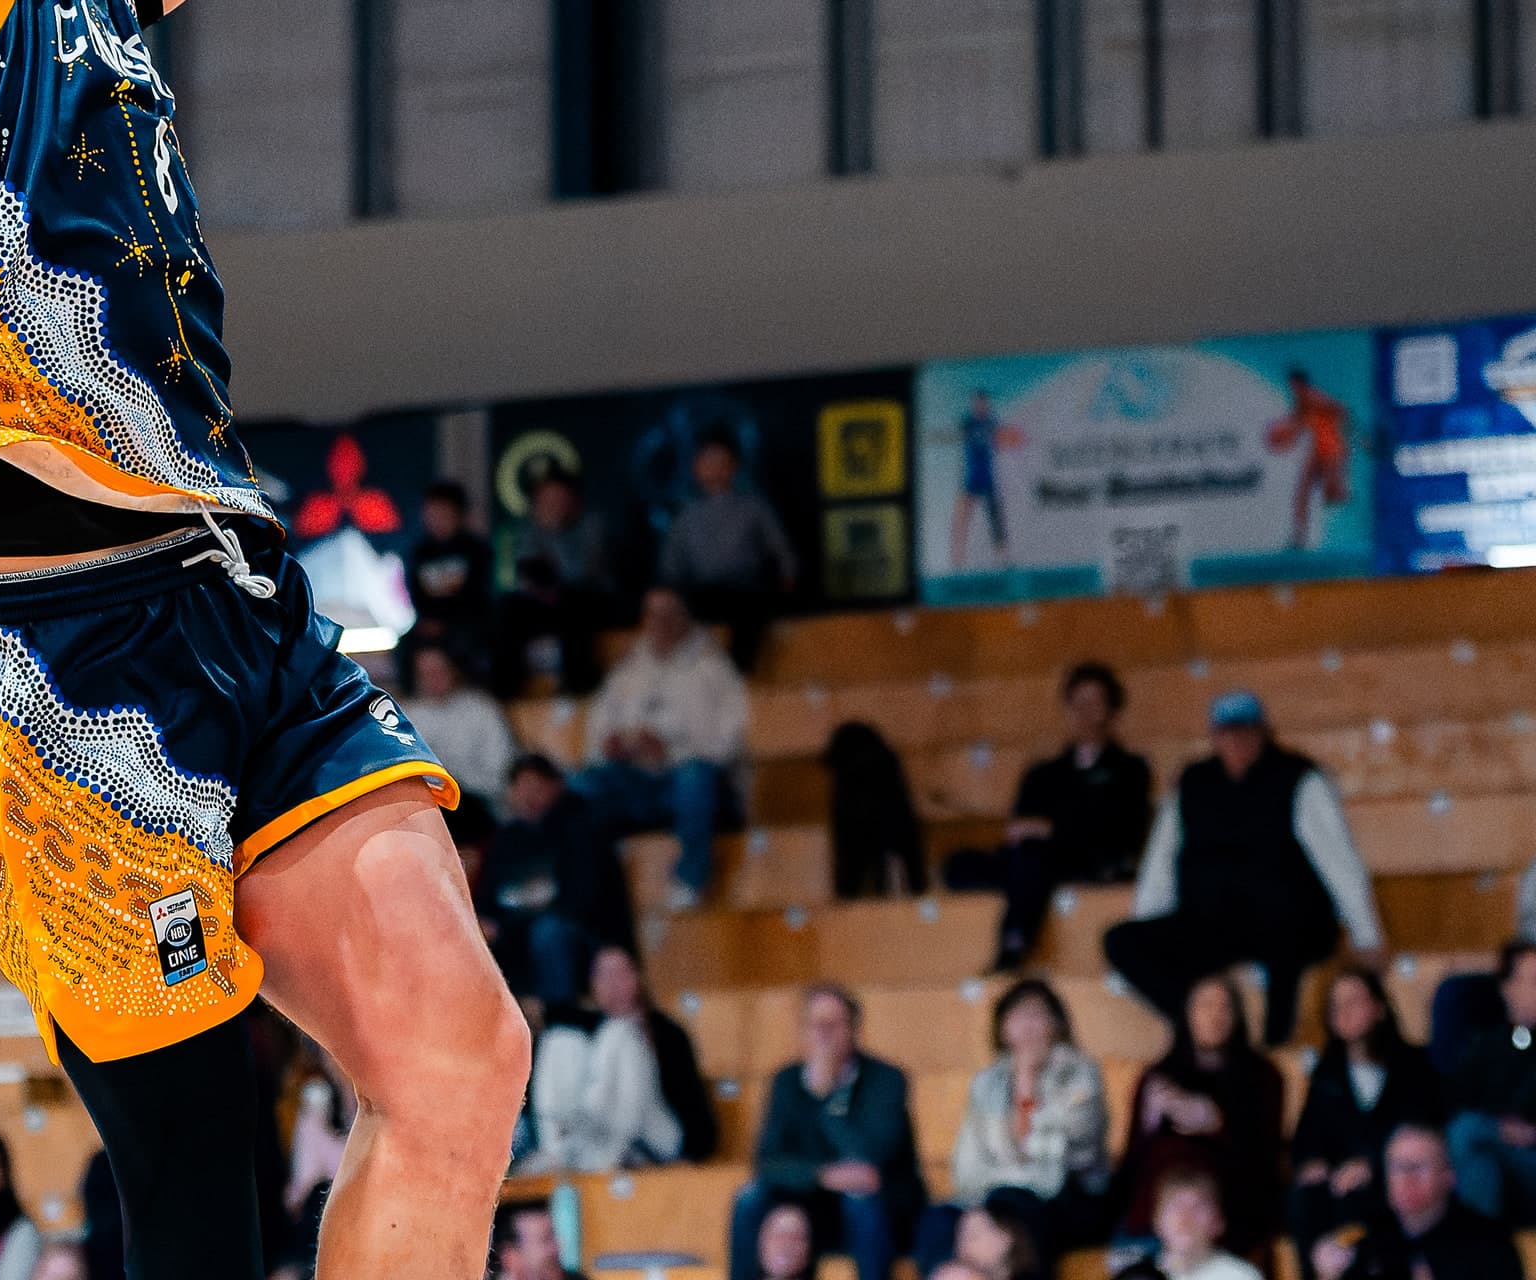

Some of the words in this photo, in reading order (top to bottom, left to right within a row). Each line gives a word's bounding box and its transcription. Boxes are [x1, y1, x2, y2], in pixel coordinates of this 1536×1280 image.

[170, 925, 187, 940] NBL
[110, 953, 132, 971] The
[168, 944, 199, 968] ONE
[47, 952, 84, 985] Respect
